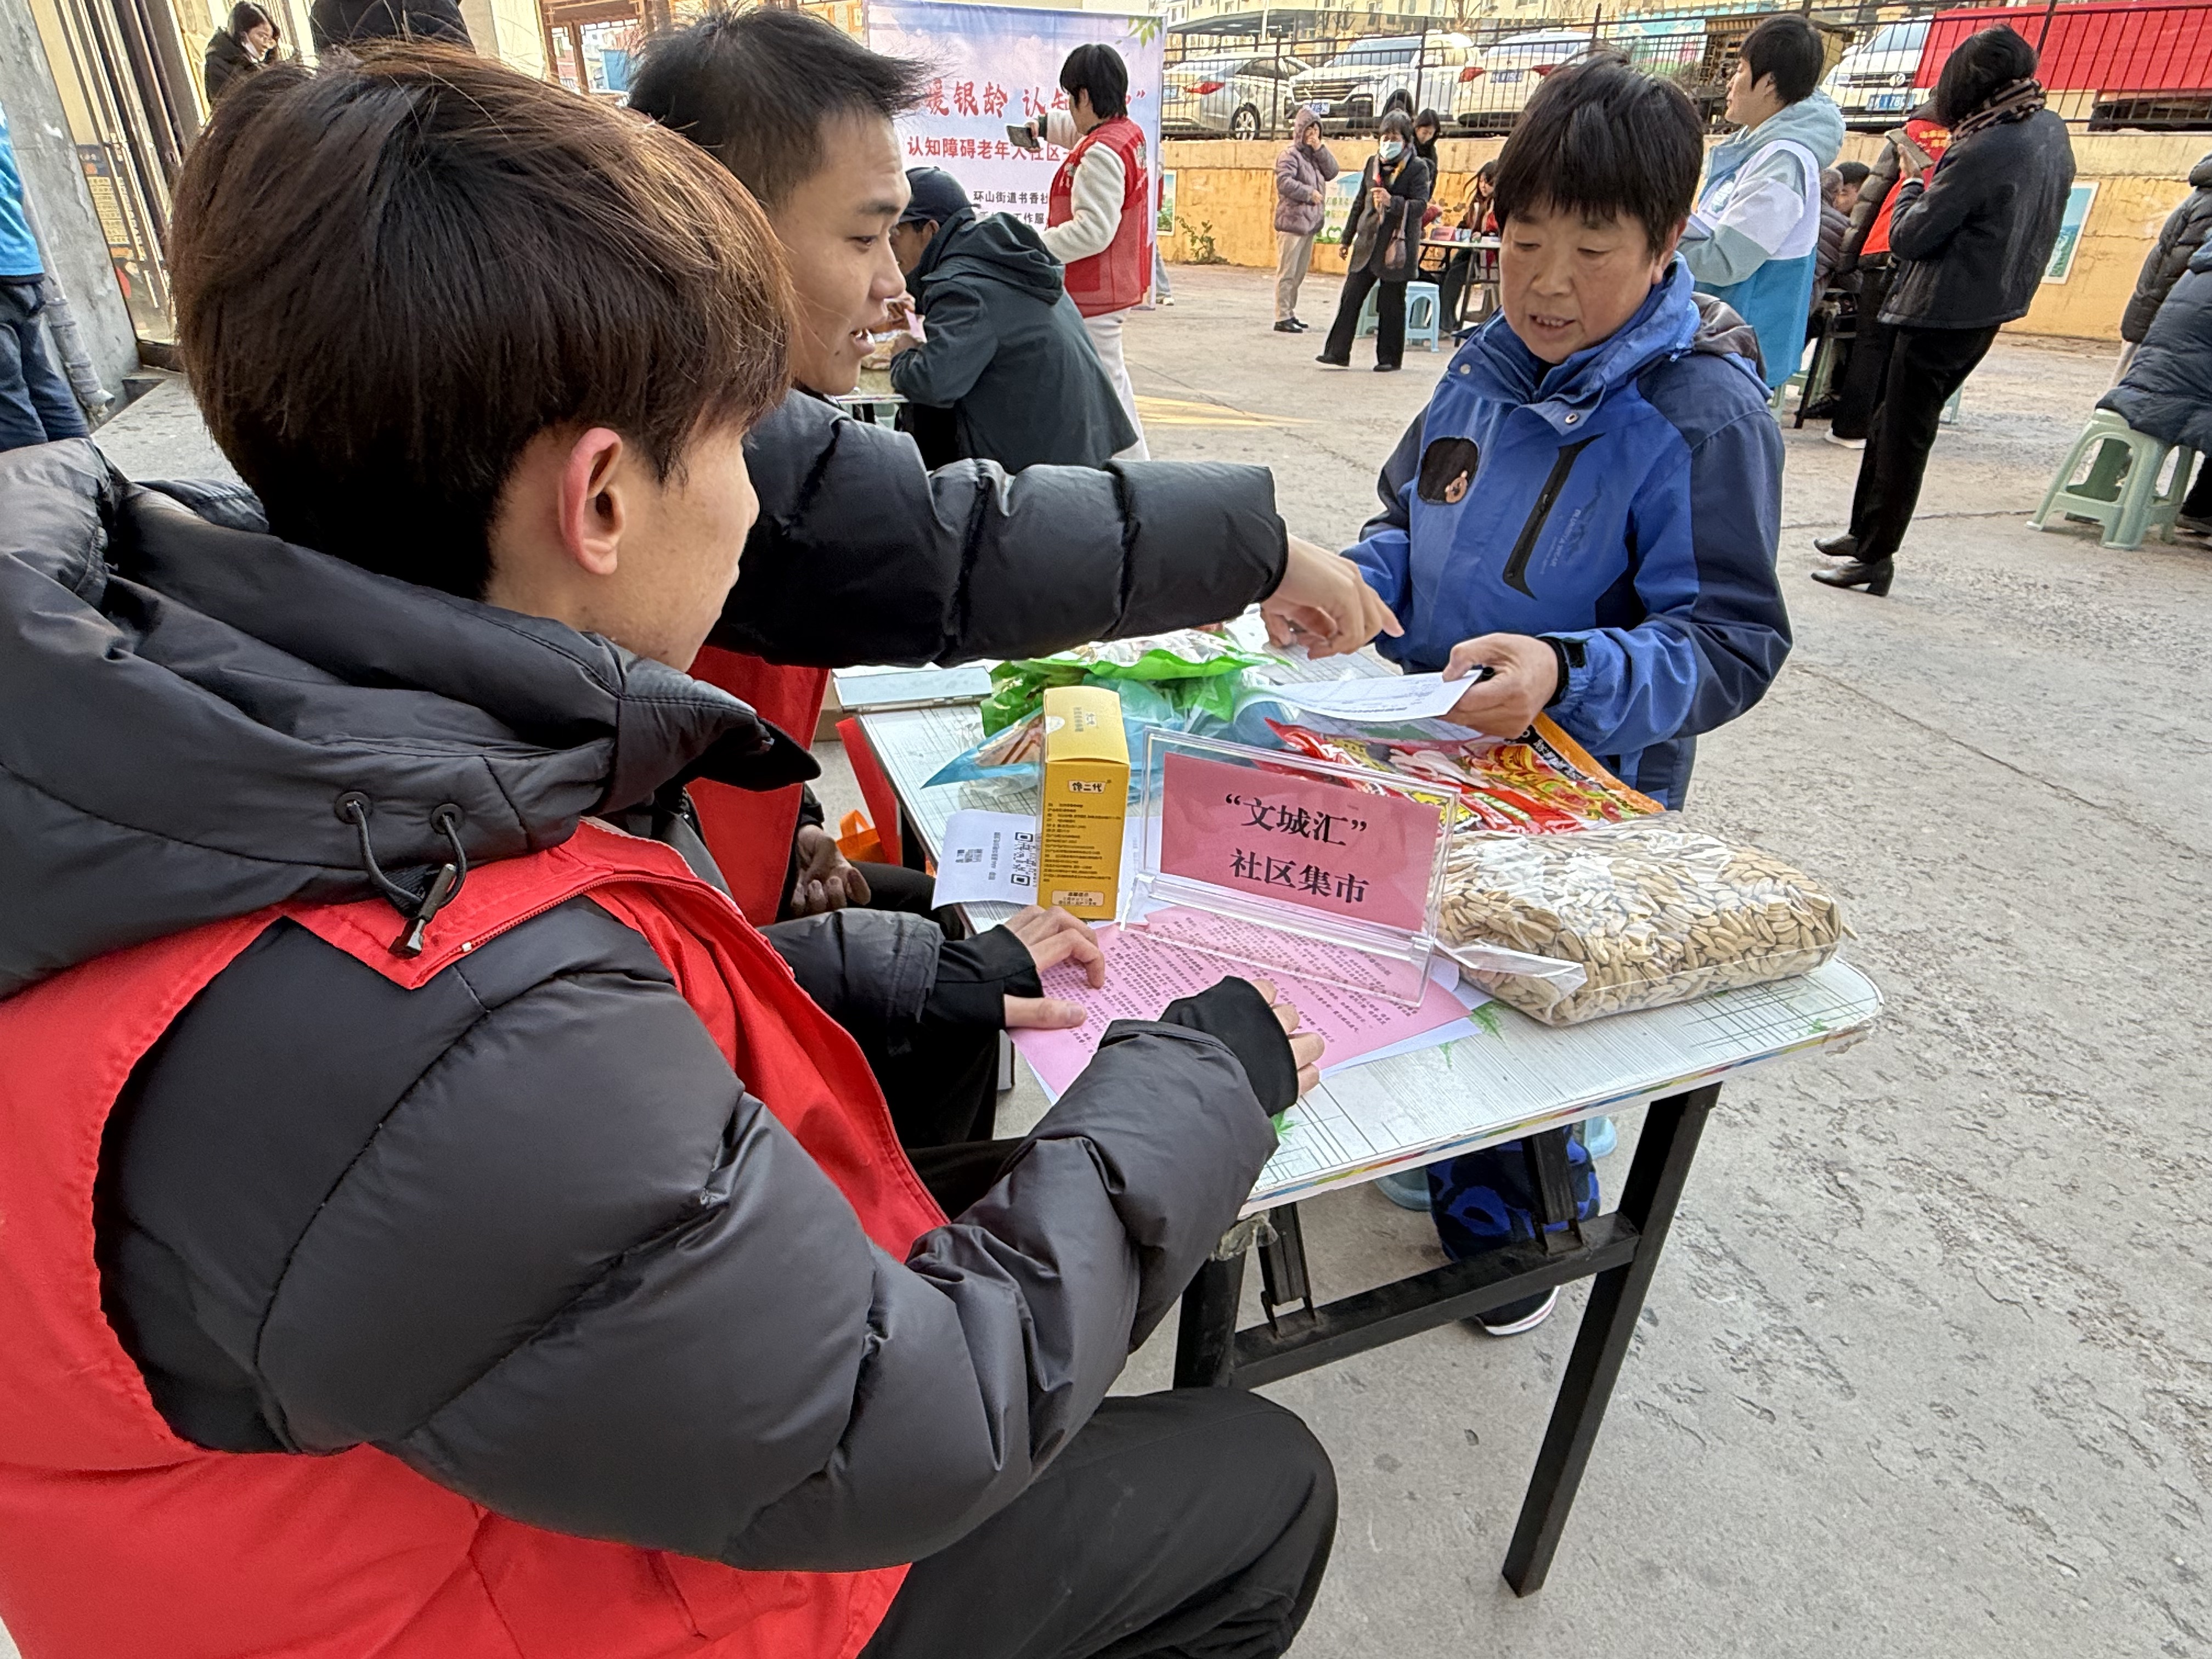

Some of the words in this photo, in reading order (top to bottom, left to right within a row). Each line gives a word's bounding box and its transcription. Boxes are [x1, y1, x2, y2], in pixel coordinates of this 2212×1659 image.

[1226, 794, 1367, 845] “文城汇”
[1229, 848, 1369, 903] 社区集市
